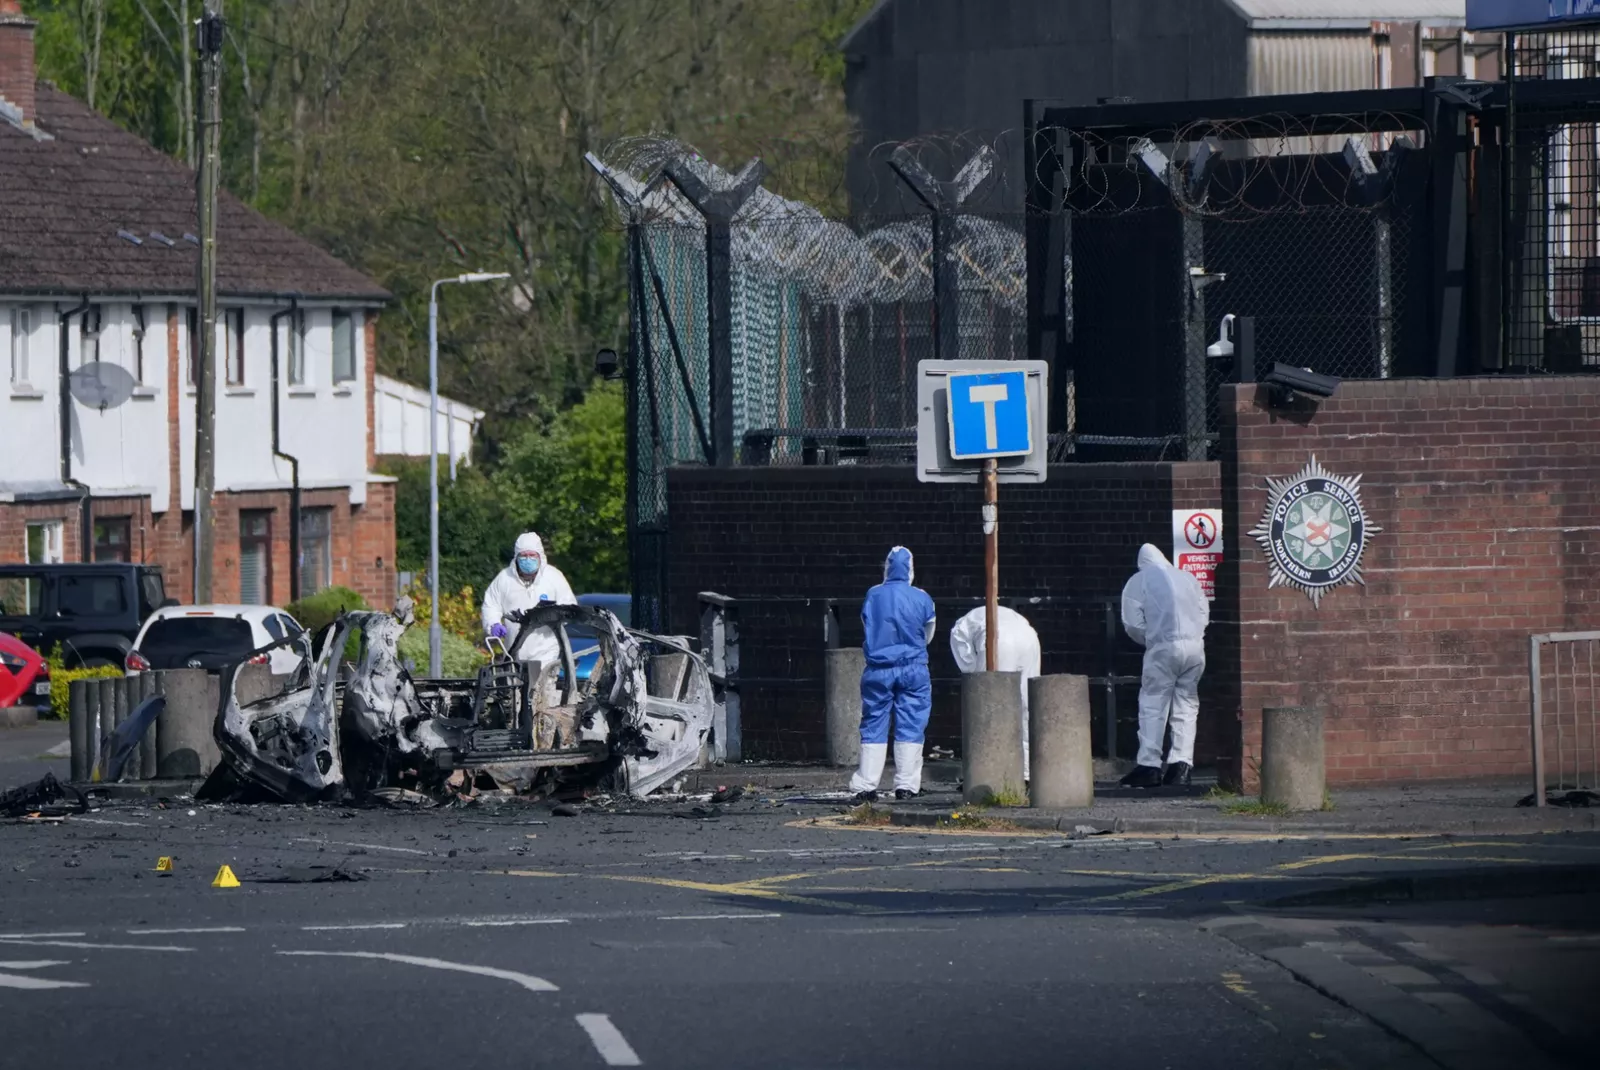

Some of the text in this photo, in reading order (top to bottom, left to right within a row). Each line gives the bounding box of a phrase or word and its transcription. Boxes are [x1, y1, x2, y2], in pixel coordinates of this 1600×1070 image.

[1275, 482, 1360, 524] POLICE SERVICE
[1183, 563, 1218, 571] ENTRANC
[1275, 539, 1358, 580] NORTHERN IRELAND
[158, 860, 166, 868] 20
